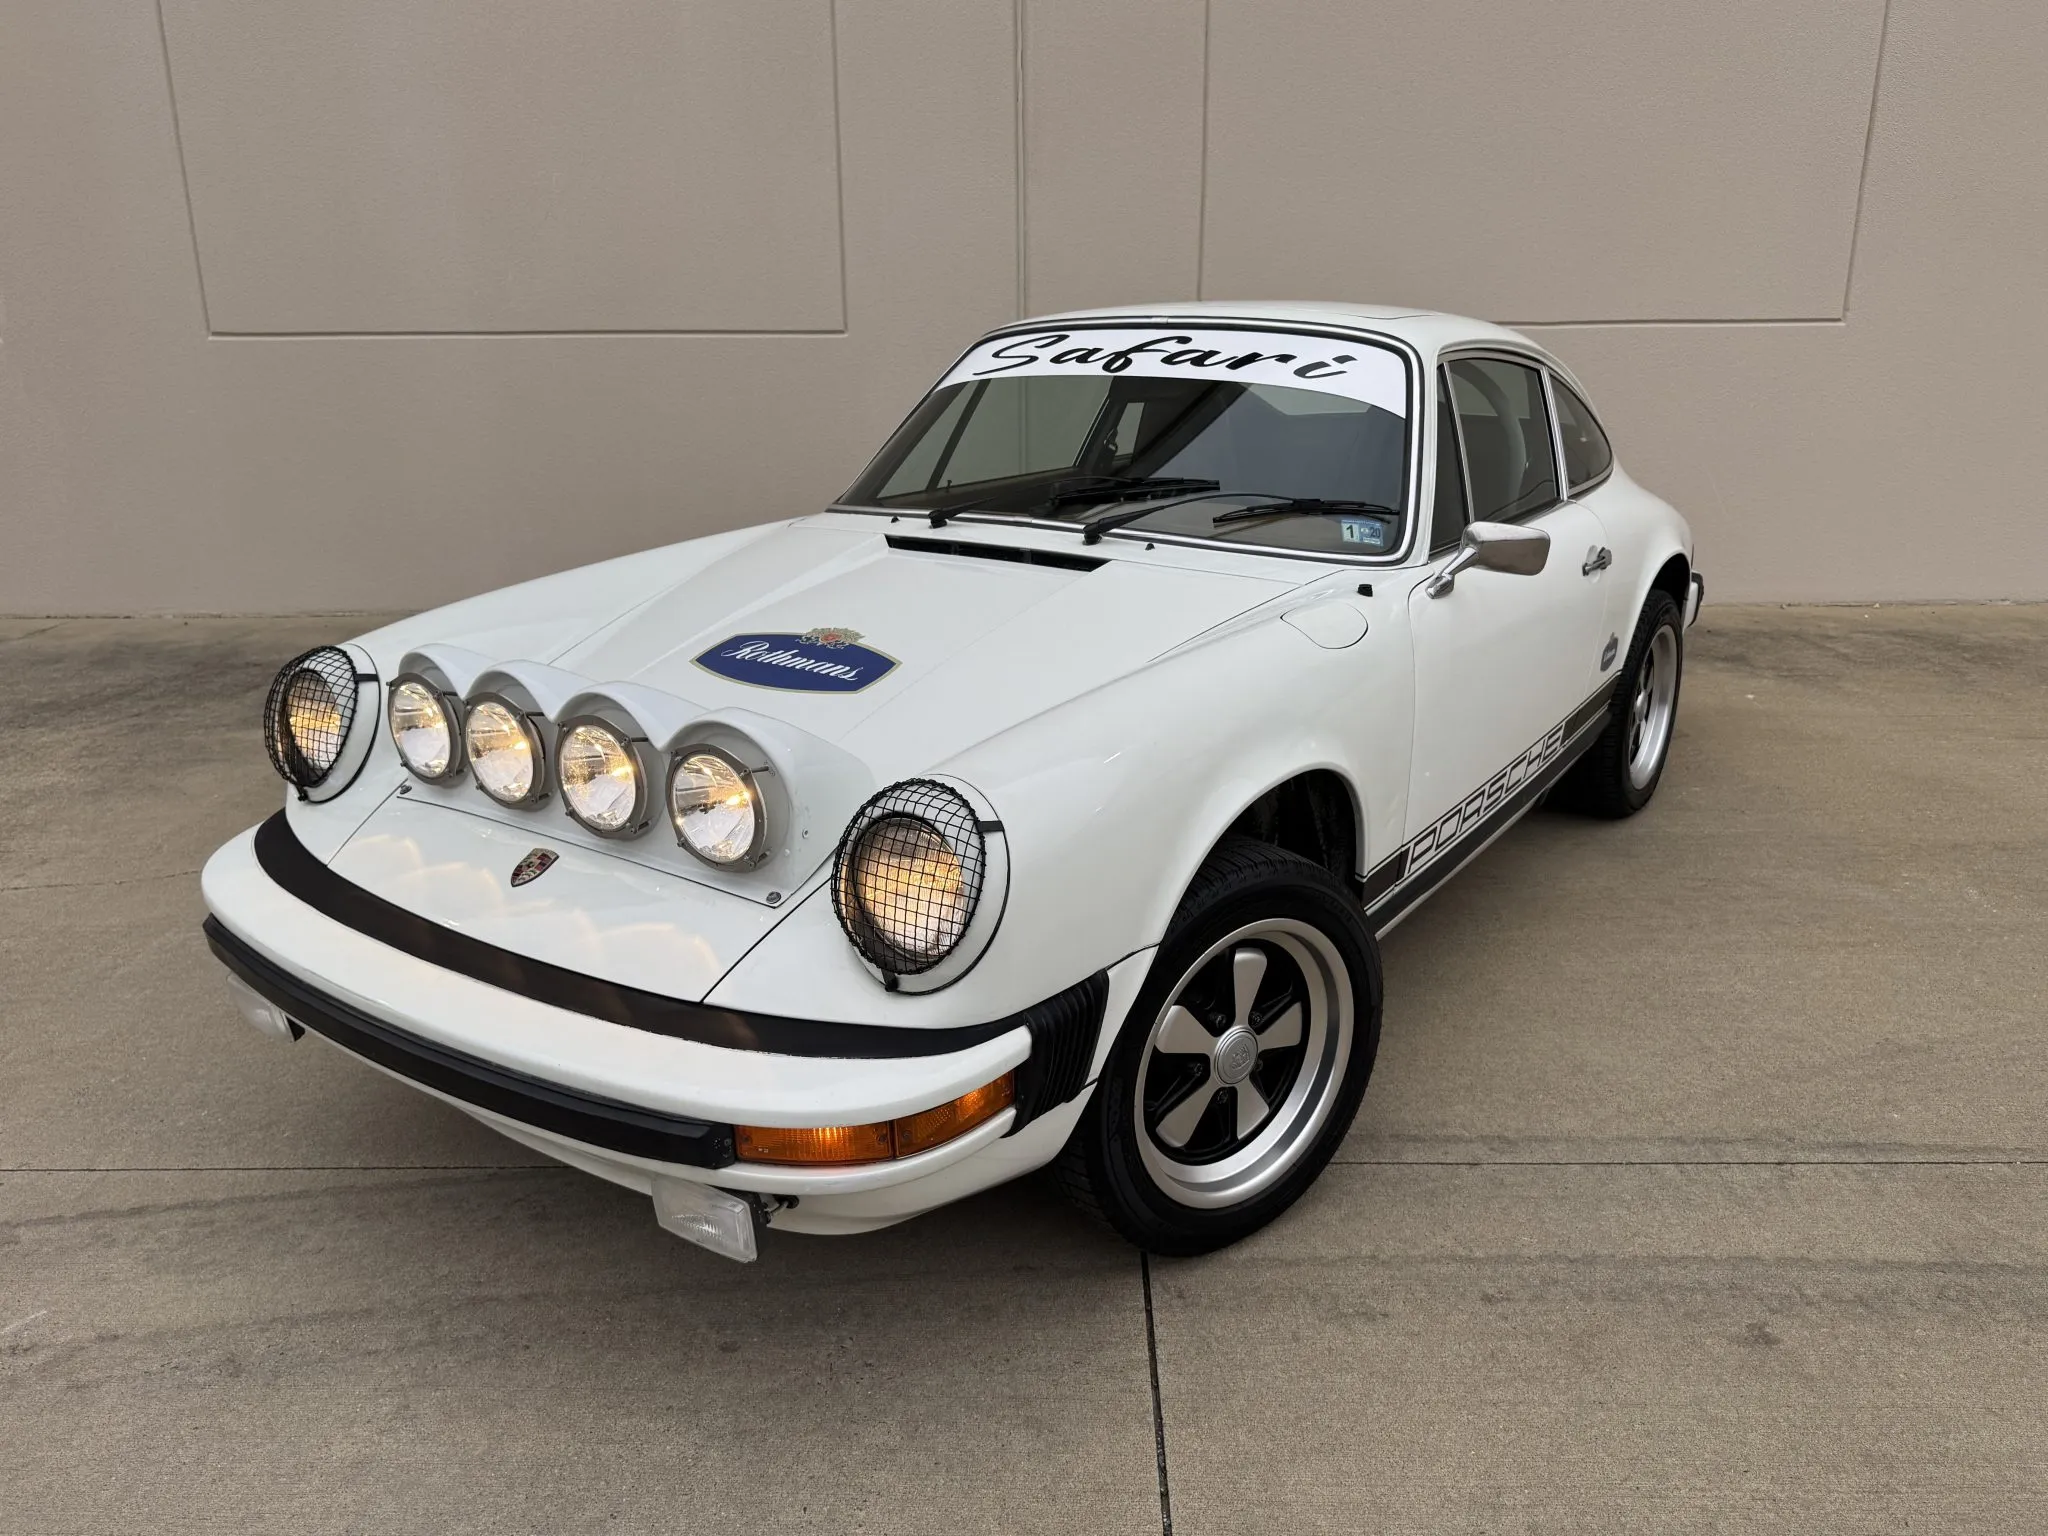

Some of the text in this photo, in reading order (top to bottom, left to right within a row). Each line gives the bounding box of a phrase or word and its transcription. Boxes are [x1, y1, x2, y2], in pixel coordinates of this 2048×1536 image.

[973, 333, 1358, 380] Safari
[1346, 524, 1354, 539] 1
[720, 640, 863, 681] Rothmans
[1407, 722, 1564, 873] PORSCHE
